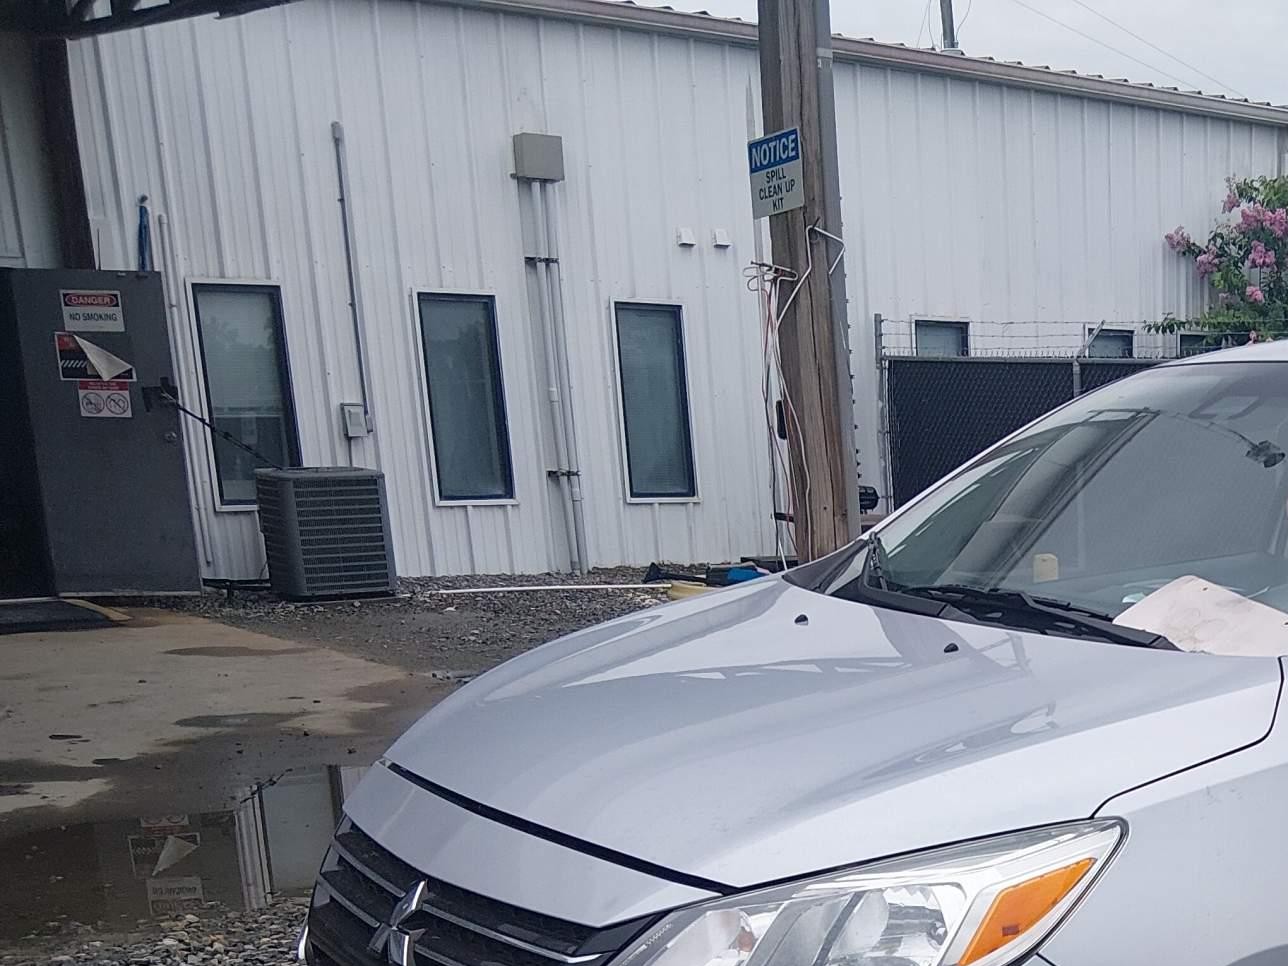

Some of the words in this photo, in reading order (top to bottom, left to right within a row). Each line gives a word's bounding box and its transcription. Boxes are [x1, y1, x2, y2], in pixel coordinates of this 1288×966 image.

[751, 134, 797, 169] NOTICE
[765, 167, 787, 184] SPILL
[759, 182, 783, 201] CLEAN
[784, 178, 796, 193] UP
[772, 196, 785, 212] KIT
[71, 296, 111, 305] DANGER
[69, 312, 80, 321] NO
[81, 312, 118, 322] SMOKING
